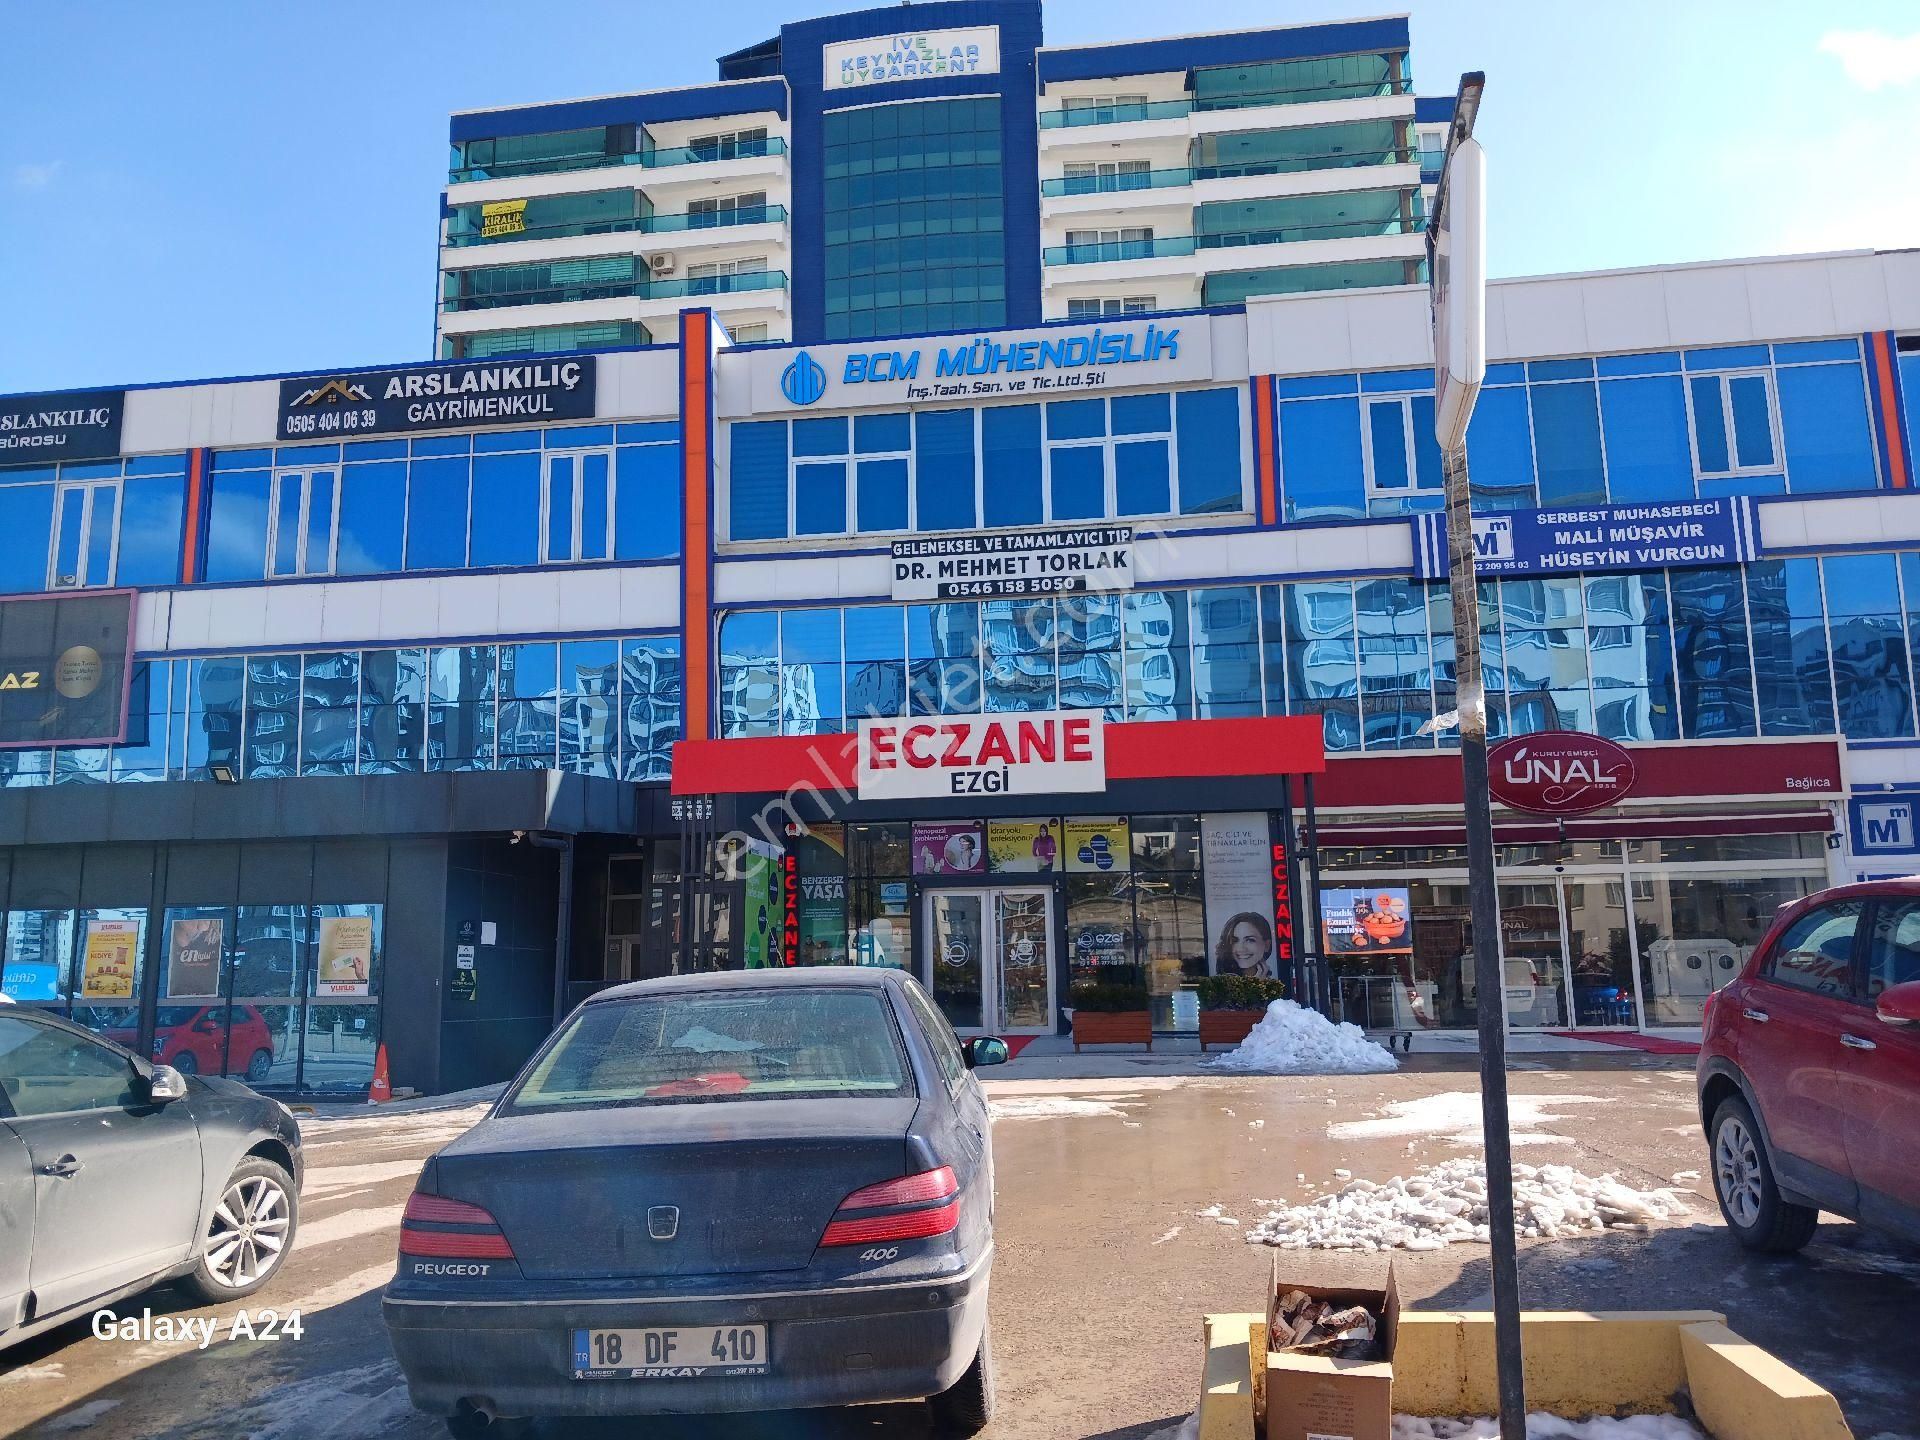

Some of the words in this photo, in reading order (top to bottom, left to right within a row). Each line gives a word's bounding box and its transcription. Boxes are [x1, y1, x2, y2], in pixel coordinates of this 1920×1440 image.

[841, 45, 979, 71] KEYMAZLAR
[842, 350, 920, 384] BCM
[935, 324, 1180, 378] MÜHENDİSLİK
[383, 362, 581, 400] ARSLANKILIÇ
[1008, 380, 1025, 390] ve
[0, 407, 109, 430] SLANKILIÇ
[286, 408, 315, 433] 0505
[318, 412, 339, 430] 404
[343, 410, 357, 429] 06
[360, 409, 376, 427] 39
[407, 394, 553, 423] GAYRİMENKUL
[1536, 510, 1608, 525] SERBEST
[1613, 500, 1720, 521] MUHASEBECİ
[893, 538, 980, 556] GELENEKSEL
[984, 537, 1002, 550] VE
[1005, 531, 1103, 549] TAMAMLAYICI
[1106, 529, 1130, 543] TIP
[1554, 526, 1603, 545] MALİ
[1609, 522, 1704, 543] MÜŞAVİR
[895, 562, 931, 581] DR.
[938, 556, 1029, 578] MEHMET
[1036, 550, 1127, 573] TORLAK
[1485, 562, 1501, 570] 209
[1540, 548, 1630, 568] HÜSEYİN
[1635, 544, 1725, 562] VURGUN
[949, 582, 993, 596] 0546
[996, 580, 1024, 593] 158
[1030, 577, 1075, 592] 5050
[869, 718, 1093, 770] ECZANE
[950, 766, 1009, 793] EZGİ
[1785, 777, 1831, 790] Bağlıca
[802, 885, 845, 901] YAŞA
[1273, 844, 1292, 959] ECZANE
[785, 856, 798, 965] ECZANE
[859, 1246, 898, 1261] 406
[413, 1263, 491, 1277] PEUGEOT
[575, 1353, 588, 1362] TR
[595, 1333, 622, 1364] 18
[644, 1331, 678, 1364] DF
[711, 1329, 756, 1361] 410
[631, 1367, 708, 1377] ERKAY
